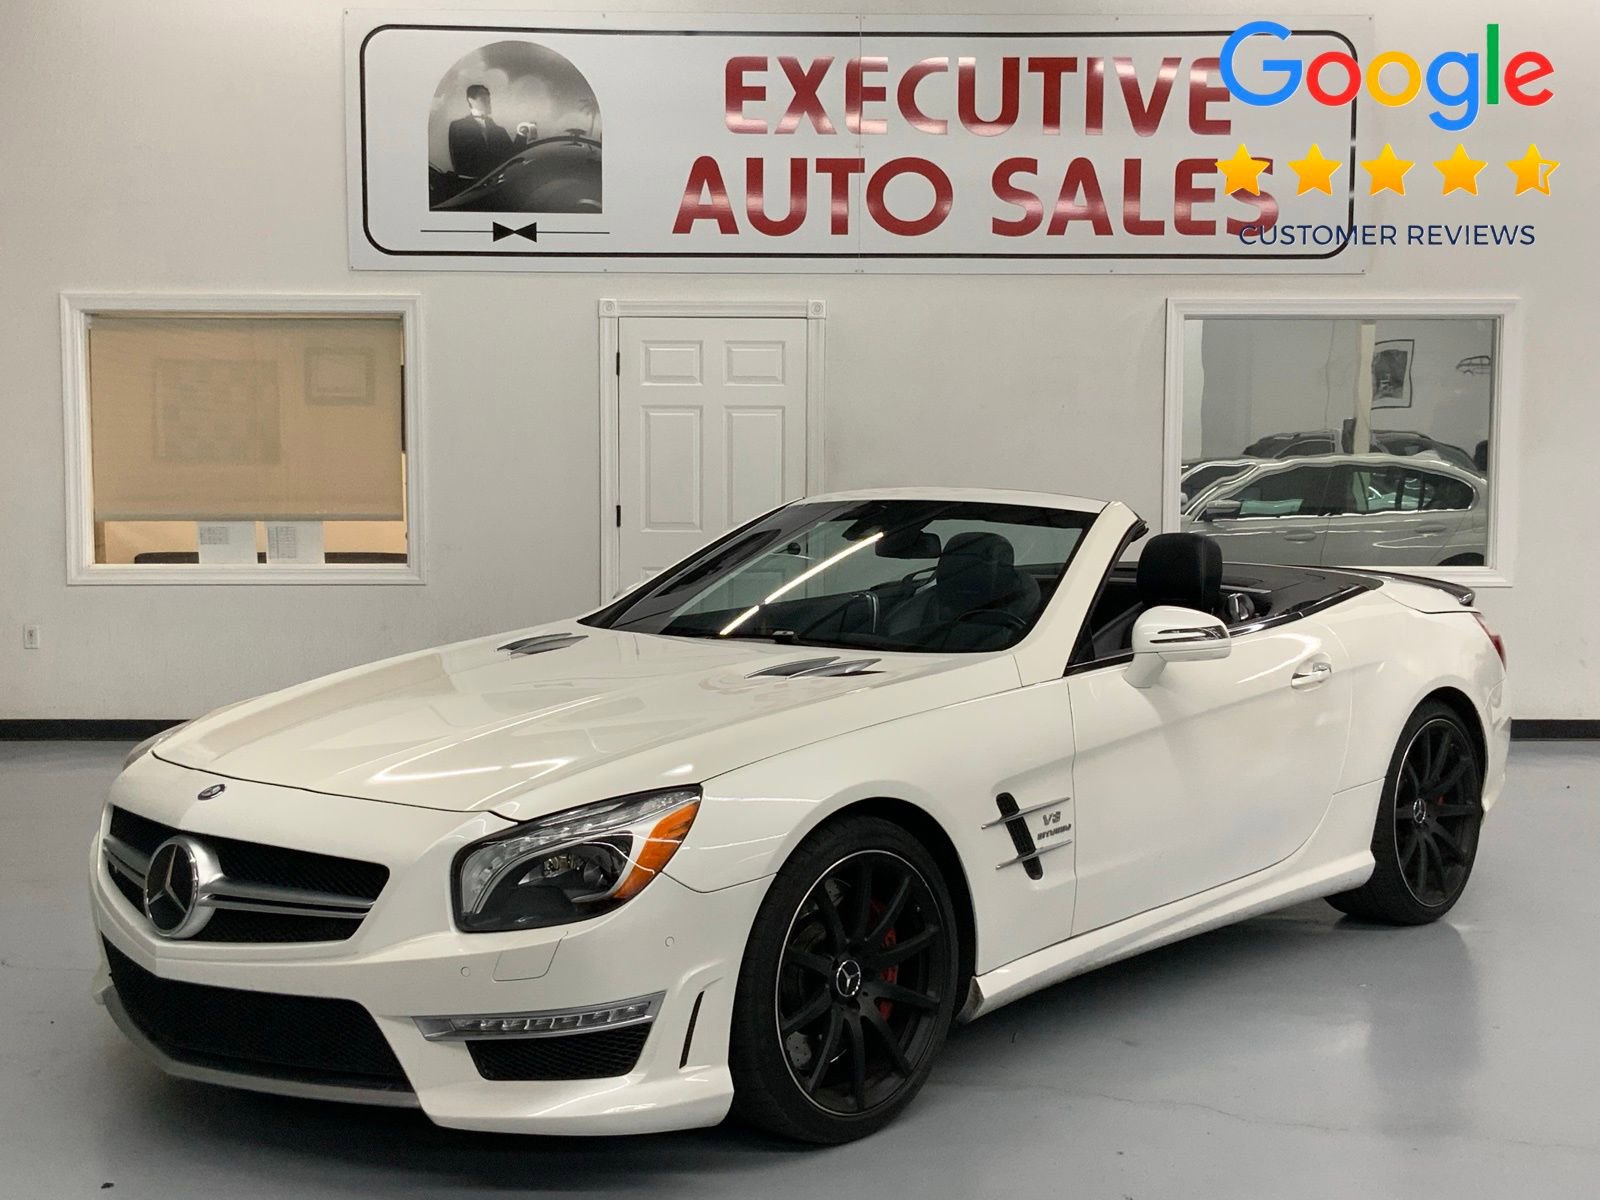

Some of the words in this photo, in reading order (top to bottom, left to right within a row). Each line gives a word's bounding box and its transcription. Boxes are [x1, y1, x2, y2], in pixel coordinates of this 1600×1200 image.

[724, 56, 1232, 136] EXECUTIVE
[672, 155, 954, 237] AUTO
[991, 157, 1279, 237] SALES
